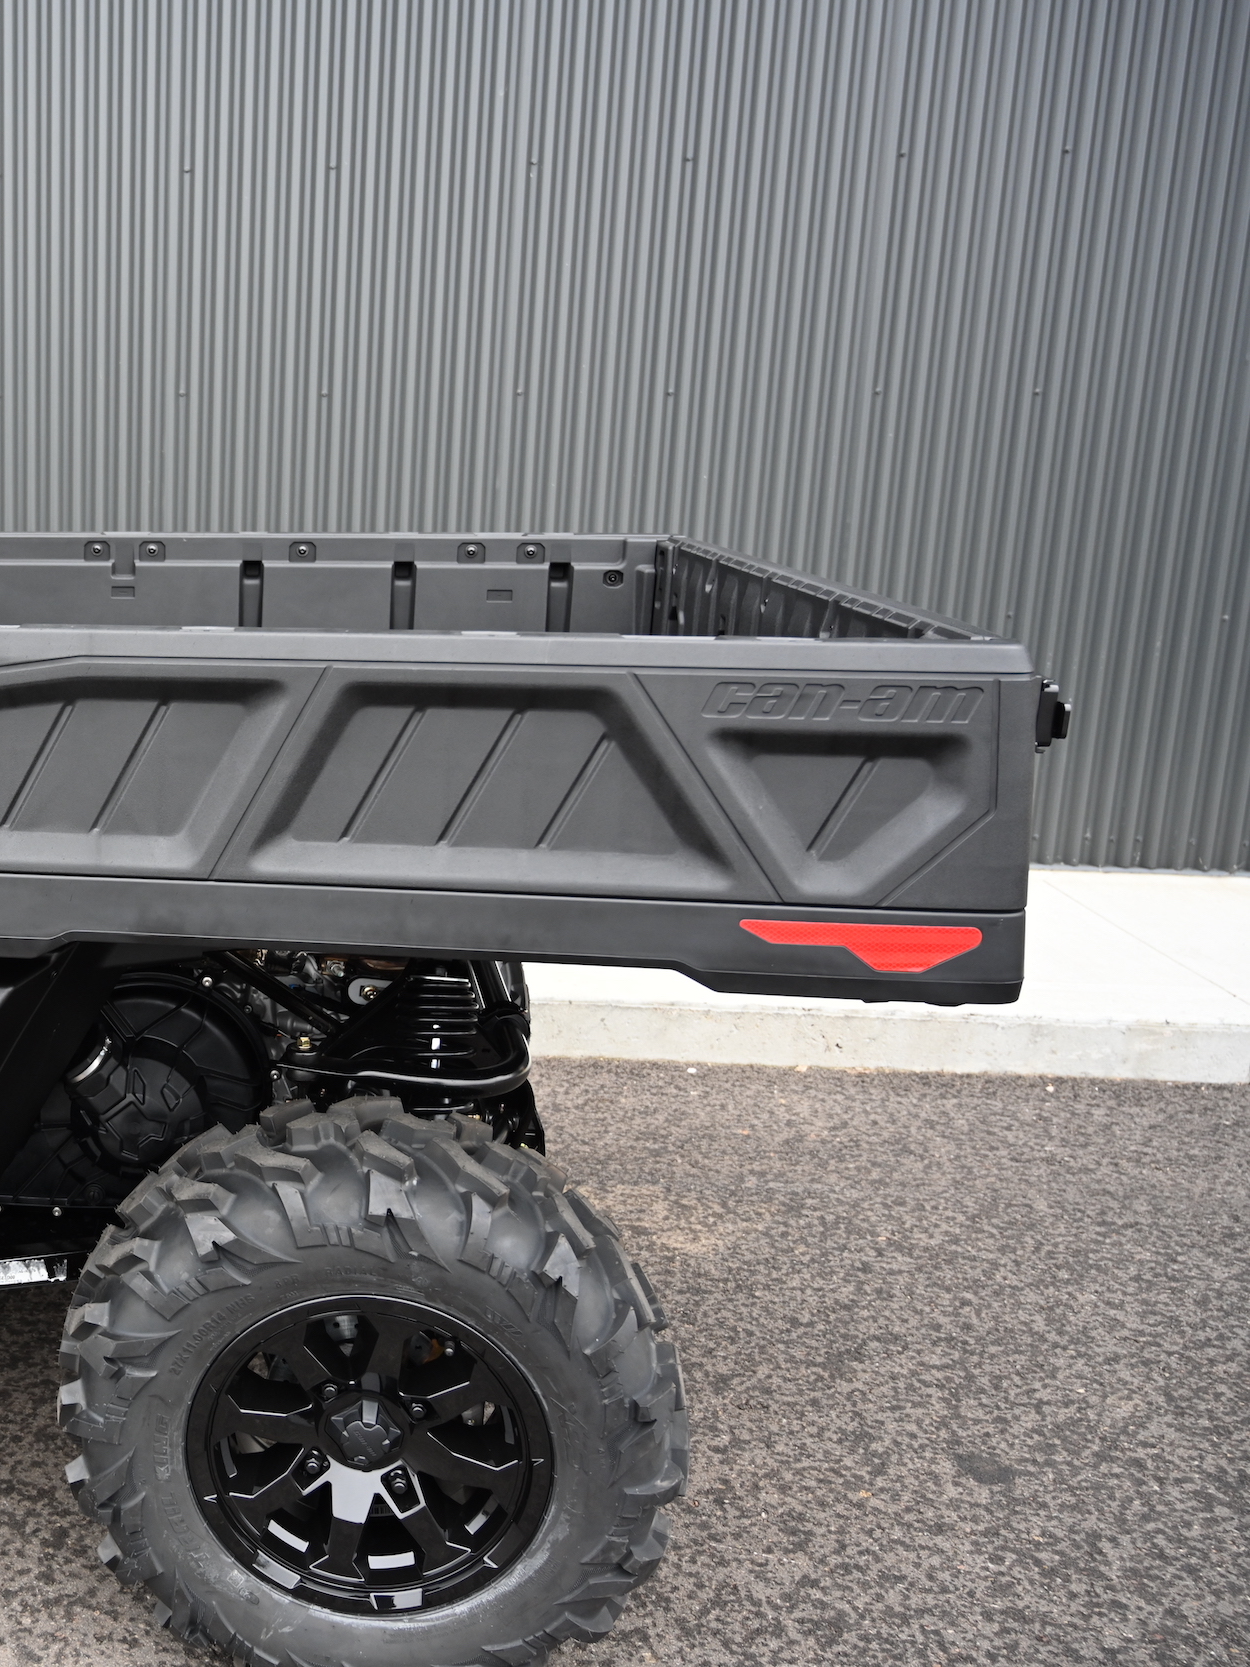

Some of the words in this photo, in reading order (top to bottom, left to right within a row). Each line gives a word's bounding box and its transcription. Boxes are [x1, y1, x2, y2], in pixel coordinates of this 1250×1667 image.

[701, 682, 985, 724] can-am
[324, 1264, 377, 1278] RADIAL
[153, 1413, 171, 1482] KING
[161, 1491, 210, 1568] TRAIL
